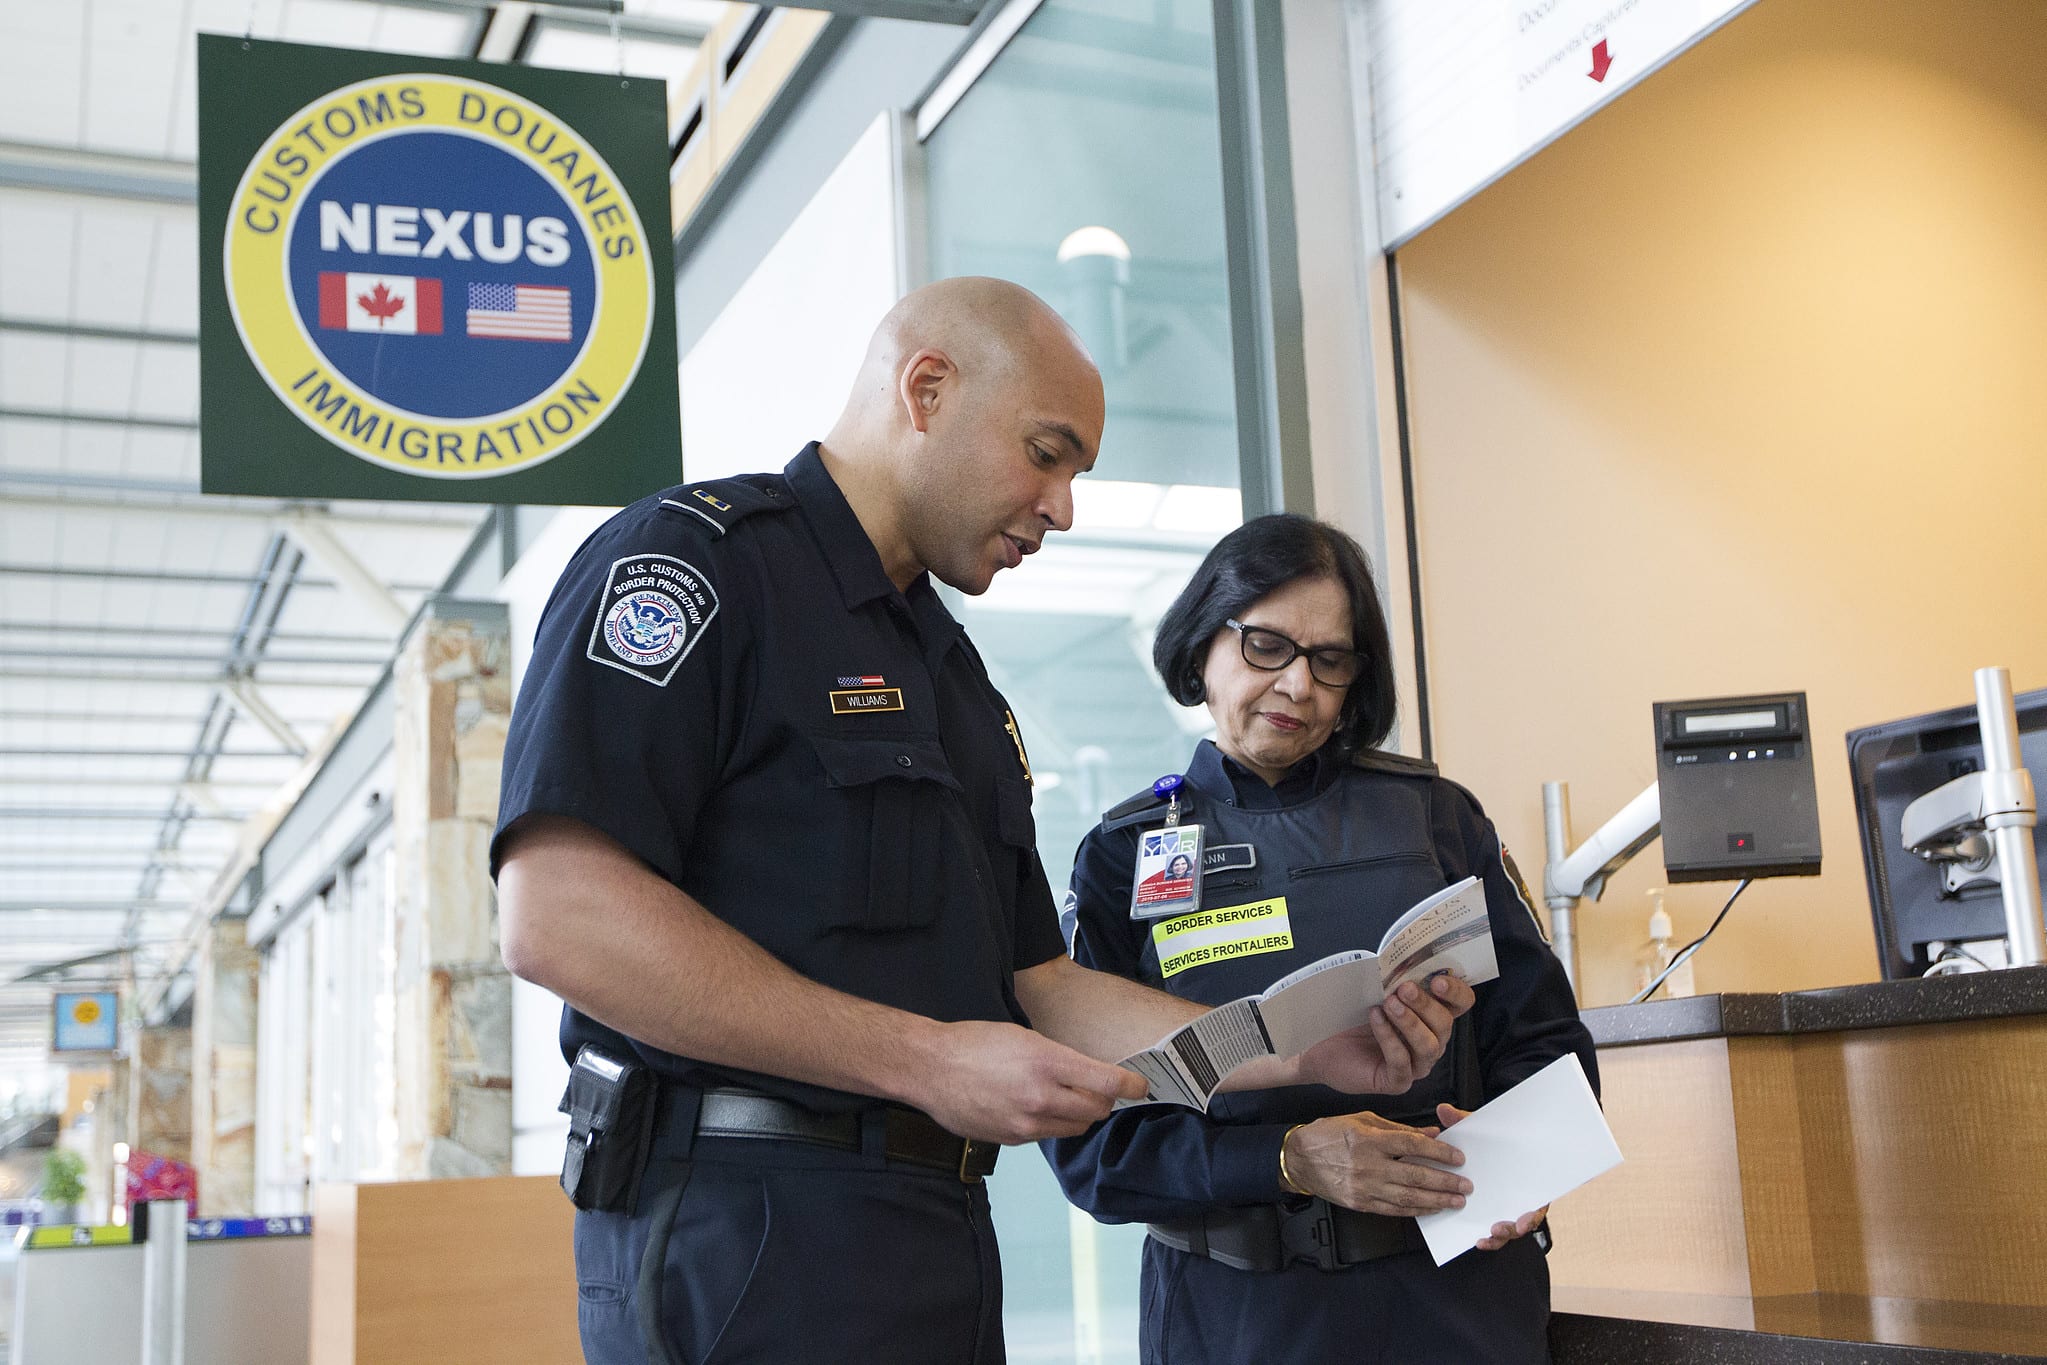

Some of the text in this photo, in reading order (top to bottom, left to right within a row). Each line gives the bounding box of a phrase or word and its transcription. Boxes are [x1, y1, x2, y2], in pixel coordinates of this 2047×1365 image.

[246, 87, 634, 260] CUSTOMS DOUANES
[319, 200, 572, 267] NEXUS
[292, 369, 601, 464] IMMIGRATION
[627, 563, 647, 575] U.S.
[650, 563, 698, 592] CUSTOMS
[613, 577, 703, 625] BORDER PROTECTION
[606, 620, 677, 662] HOMELAND SECURITY
[847, 694, 888, 707] WILLIAMS
[1144, 839, 1196, 857] YVR
[1166, 904, 1273, 935] BORDER SERVICES
[1163, 935, 1289, 974] SERVICES FRONTALIERS
